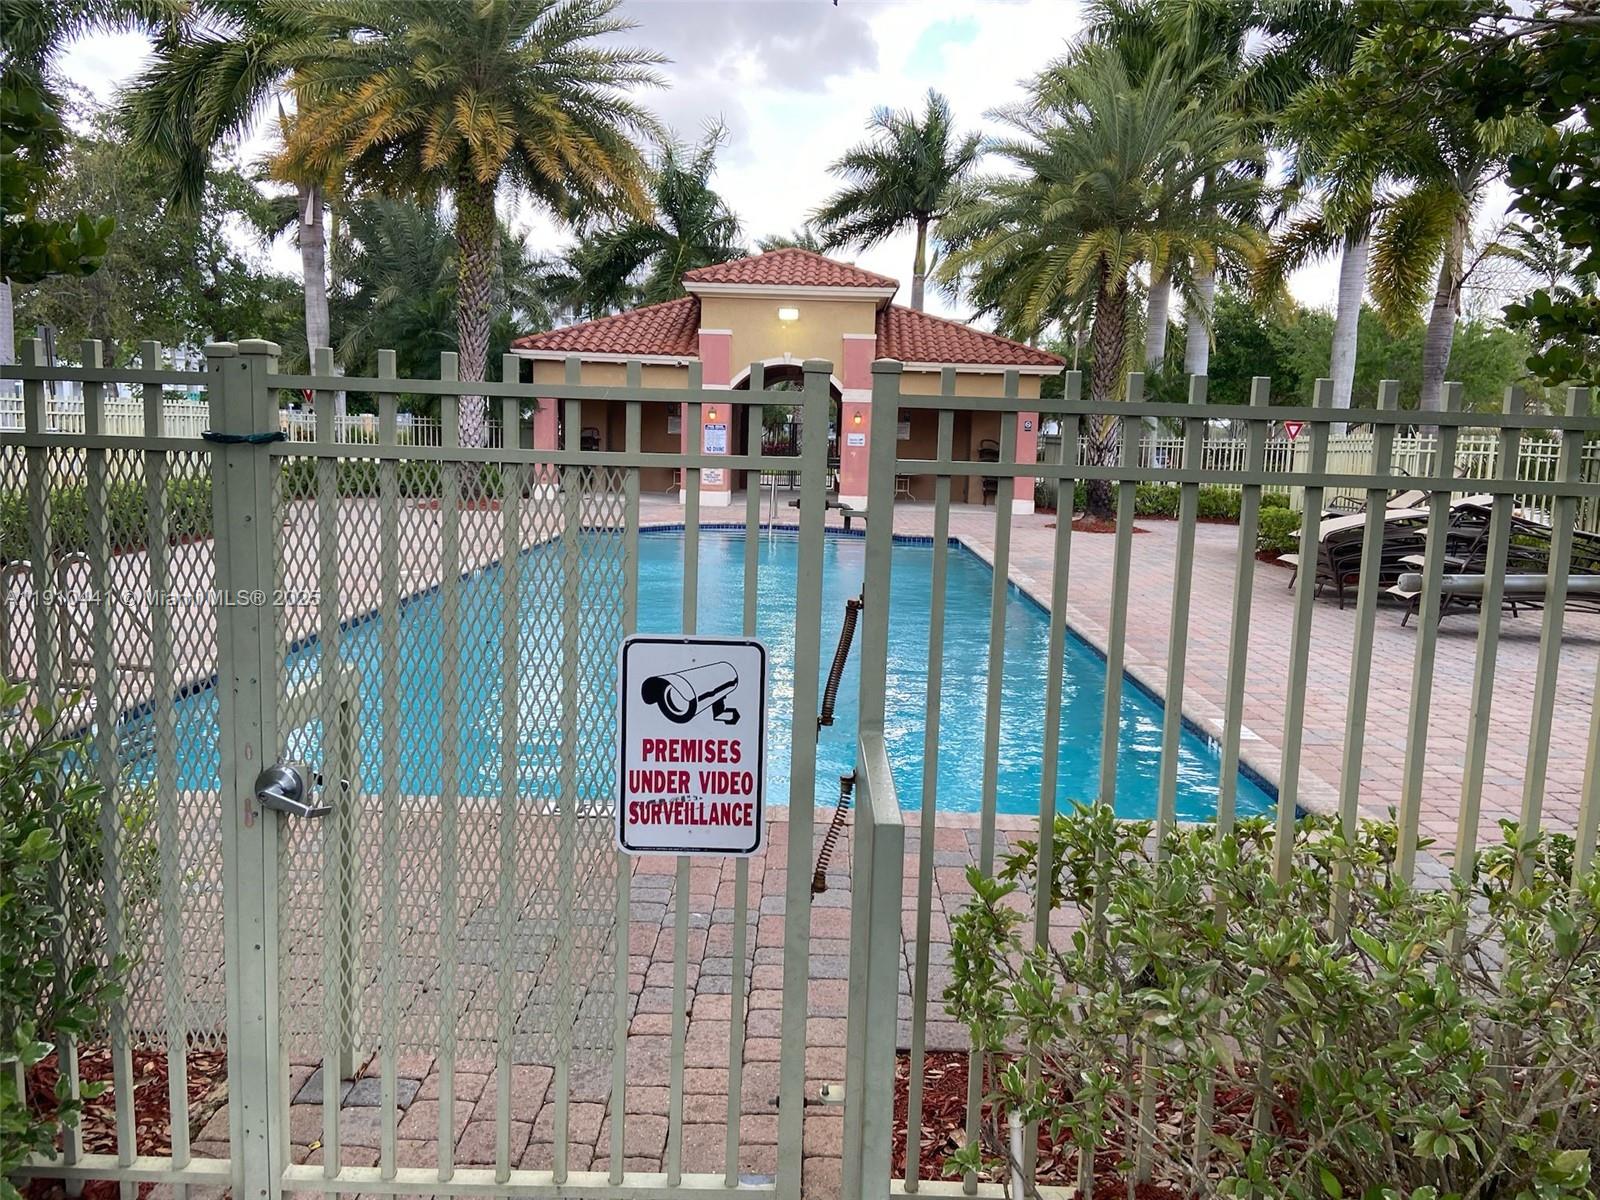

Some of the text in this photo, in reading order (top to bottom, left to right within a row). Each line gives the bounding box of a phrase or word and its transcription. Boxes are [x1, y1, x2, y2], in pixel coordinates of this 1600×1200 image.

[642, 738, 741, 764] PREMISES
[628, 770, 753, 795] UNDER VIDEO
[628, 801, 753, 827] SURVEILLANCE
